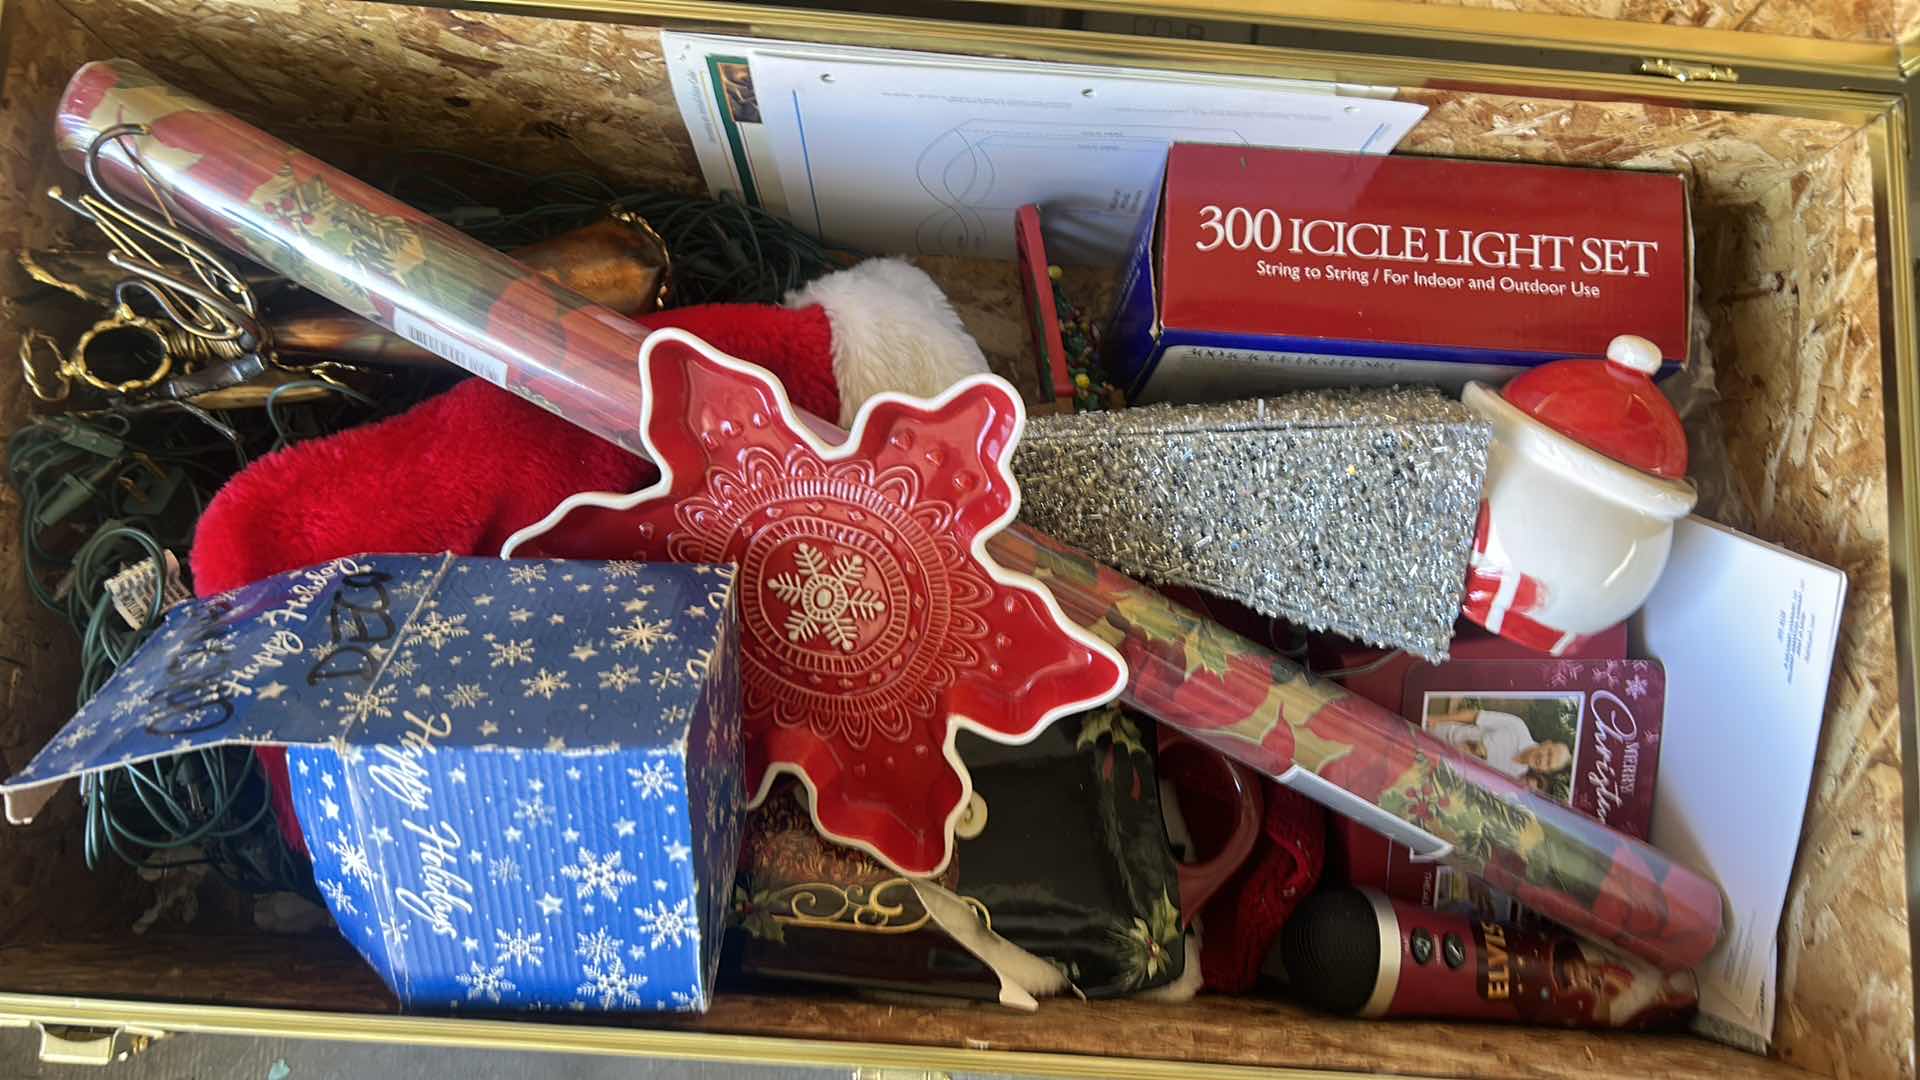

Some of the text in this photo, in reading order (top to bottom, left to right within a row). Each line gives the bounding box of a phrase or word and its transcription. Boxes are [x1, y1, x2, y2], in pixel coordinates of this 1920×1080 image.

[1195, 205, 1658, 277] 300 ICICLE LIGHT SET
[1256, 260, 1600, 298] String to String / For Indoor and Outdoor Use
[222, 630, 304, 698] Happy
[1587, 689, 1638, 825] Christm
[1620, 741, 1640, 795] MERRY
[367, 709, 473, 940] Happy Holidays
[1480, 921, 1510, 999] ELVIS
